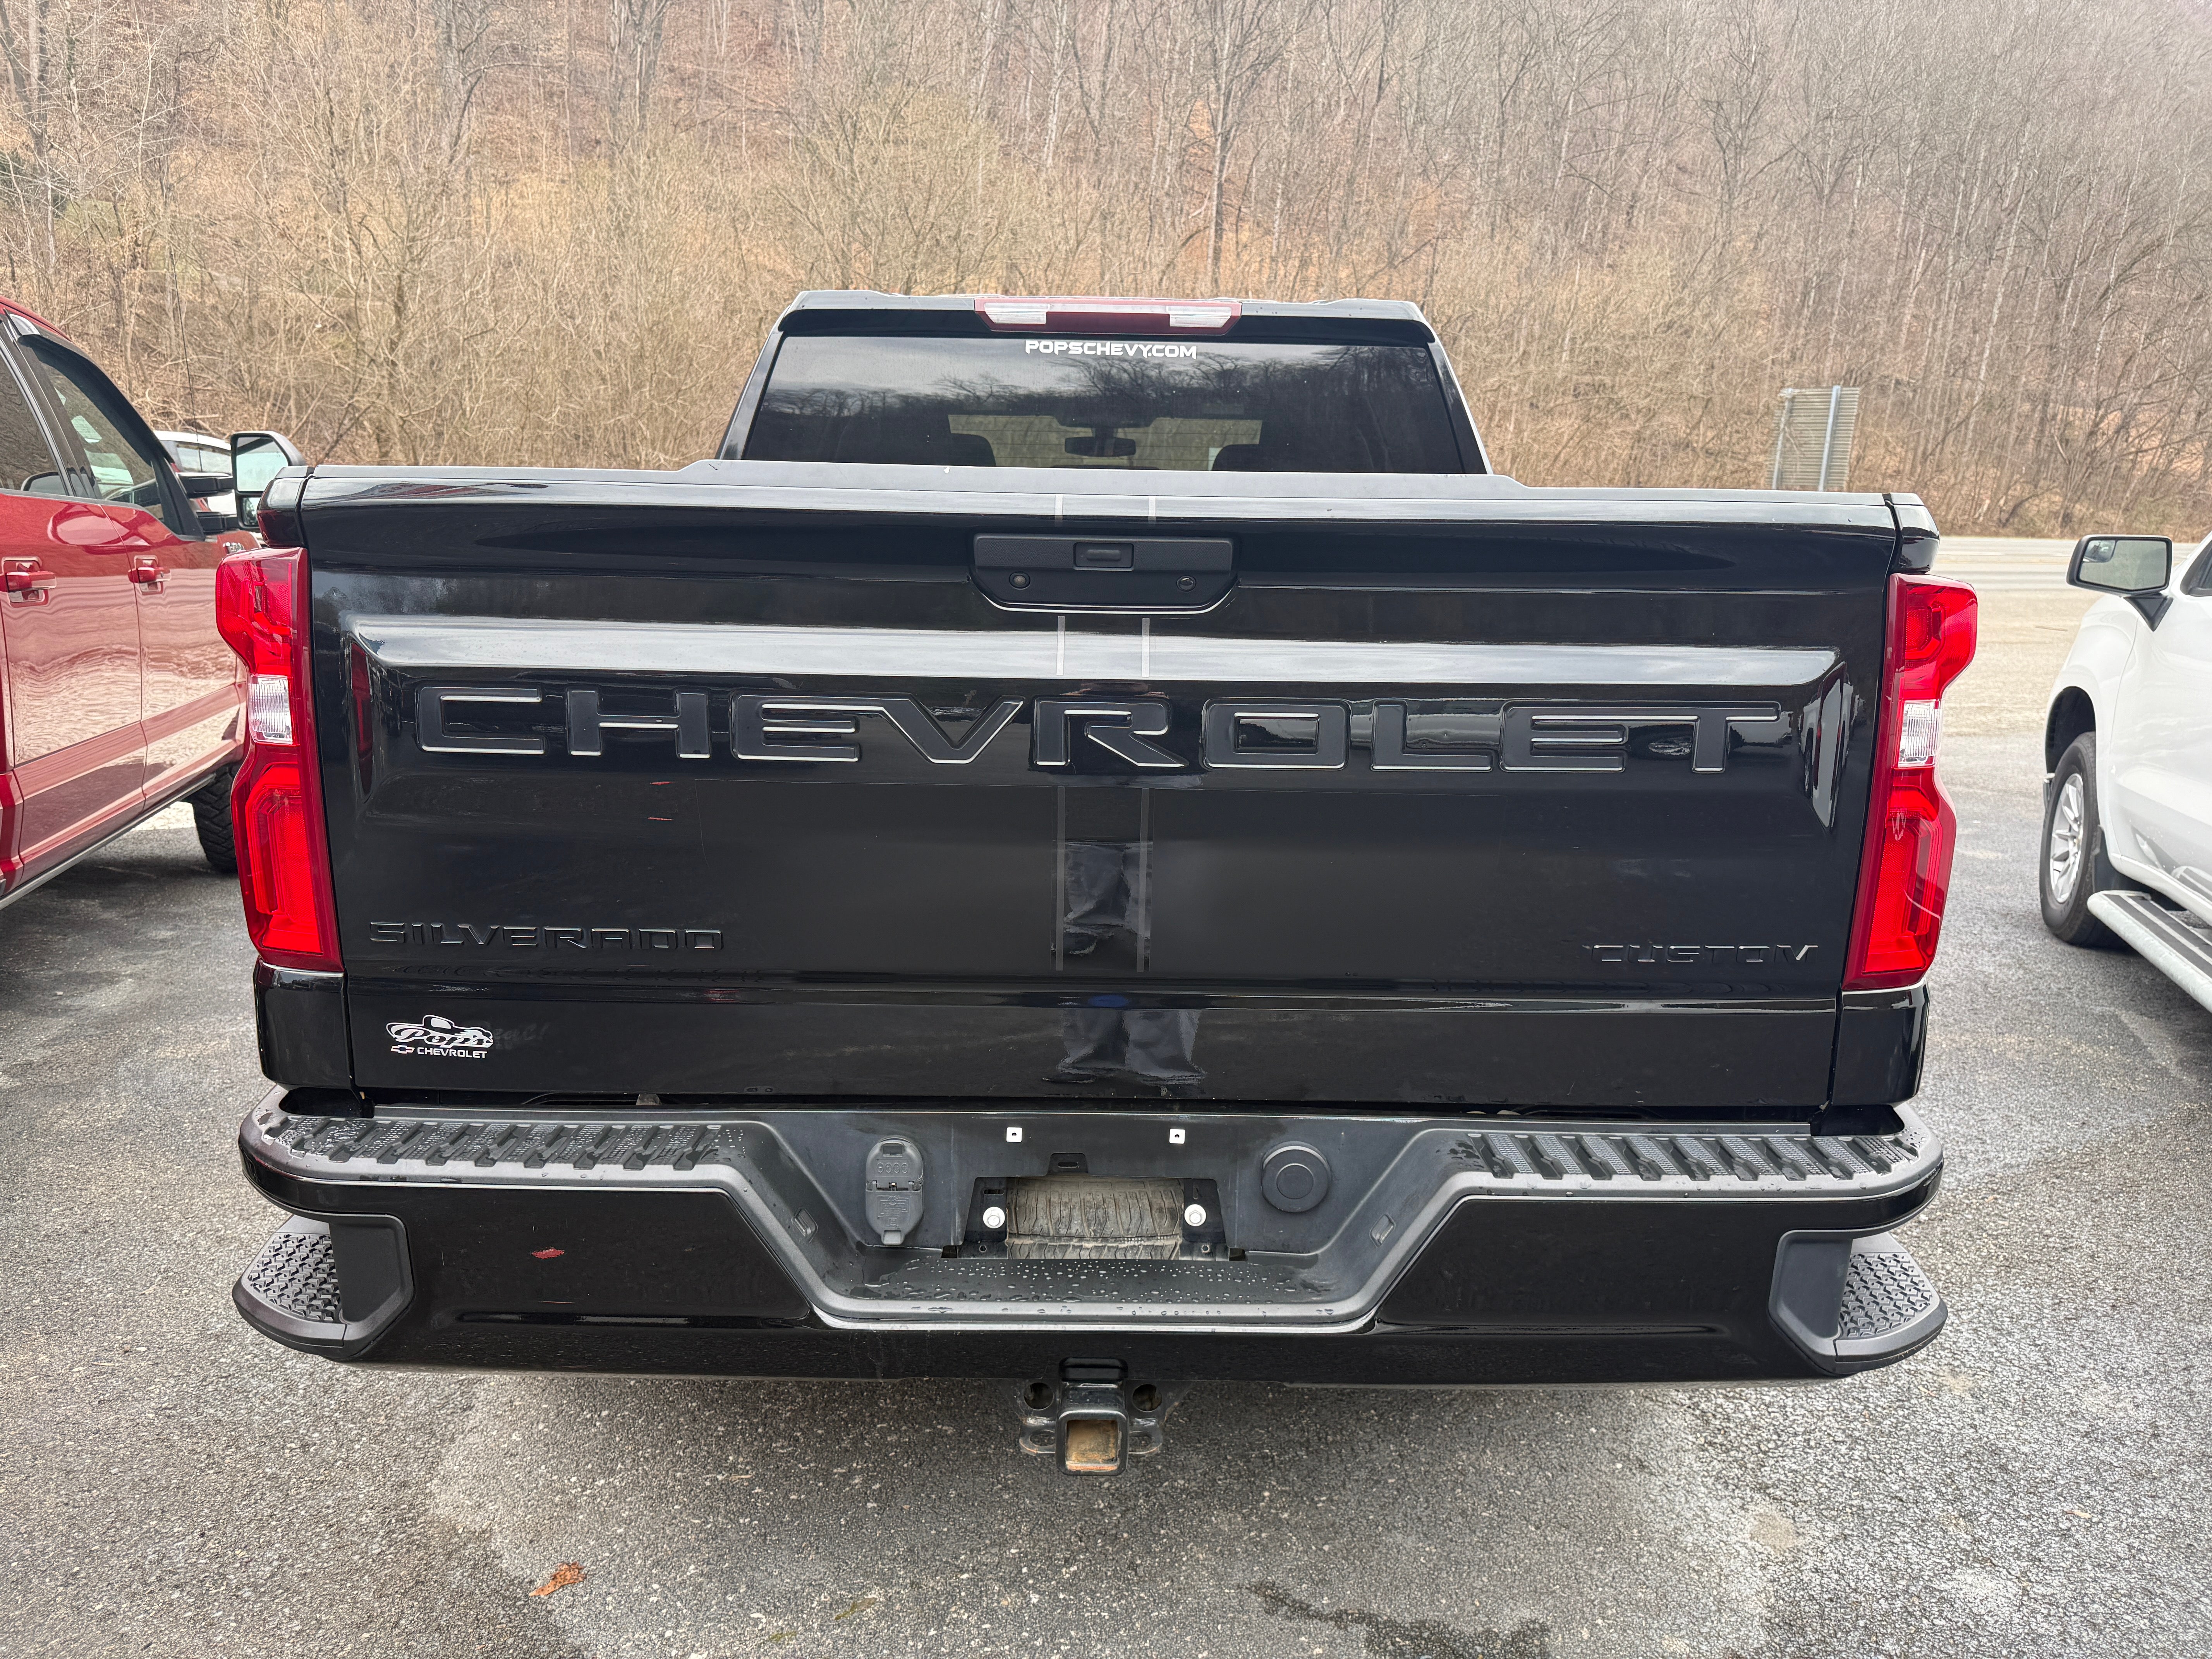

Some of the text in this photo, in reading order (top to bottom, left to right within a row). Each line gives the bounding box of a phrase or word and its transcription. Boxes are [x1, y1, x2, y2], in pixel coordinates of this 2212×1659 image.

[1025, 340, 1197, 359] POPSCHEVY.COM
[417, 686, 1781, 773] CHEVROLET
[369, 922, 723, 950] SILVERADO
[1591, 944, 1818, 964] CUSTOM
[417, 1047, 487, 1058] CHEVROLET
